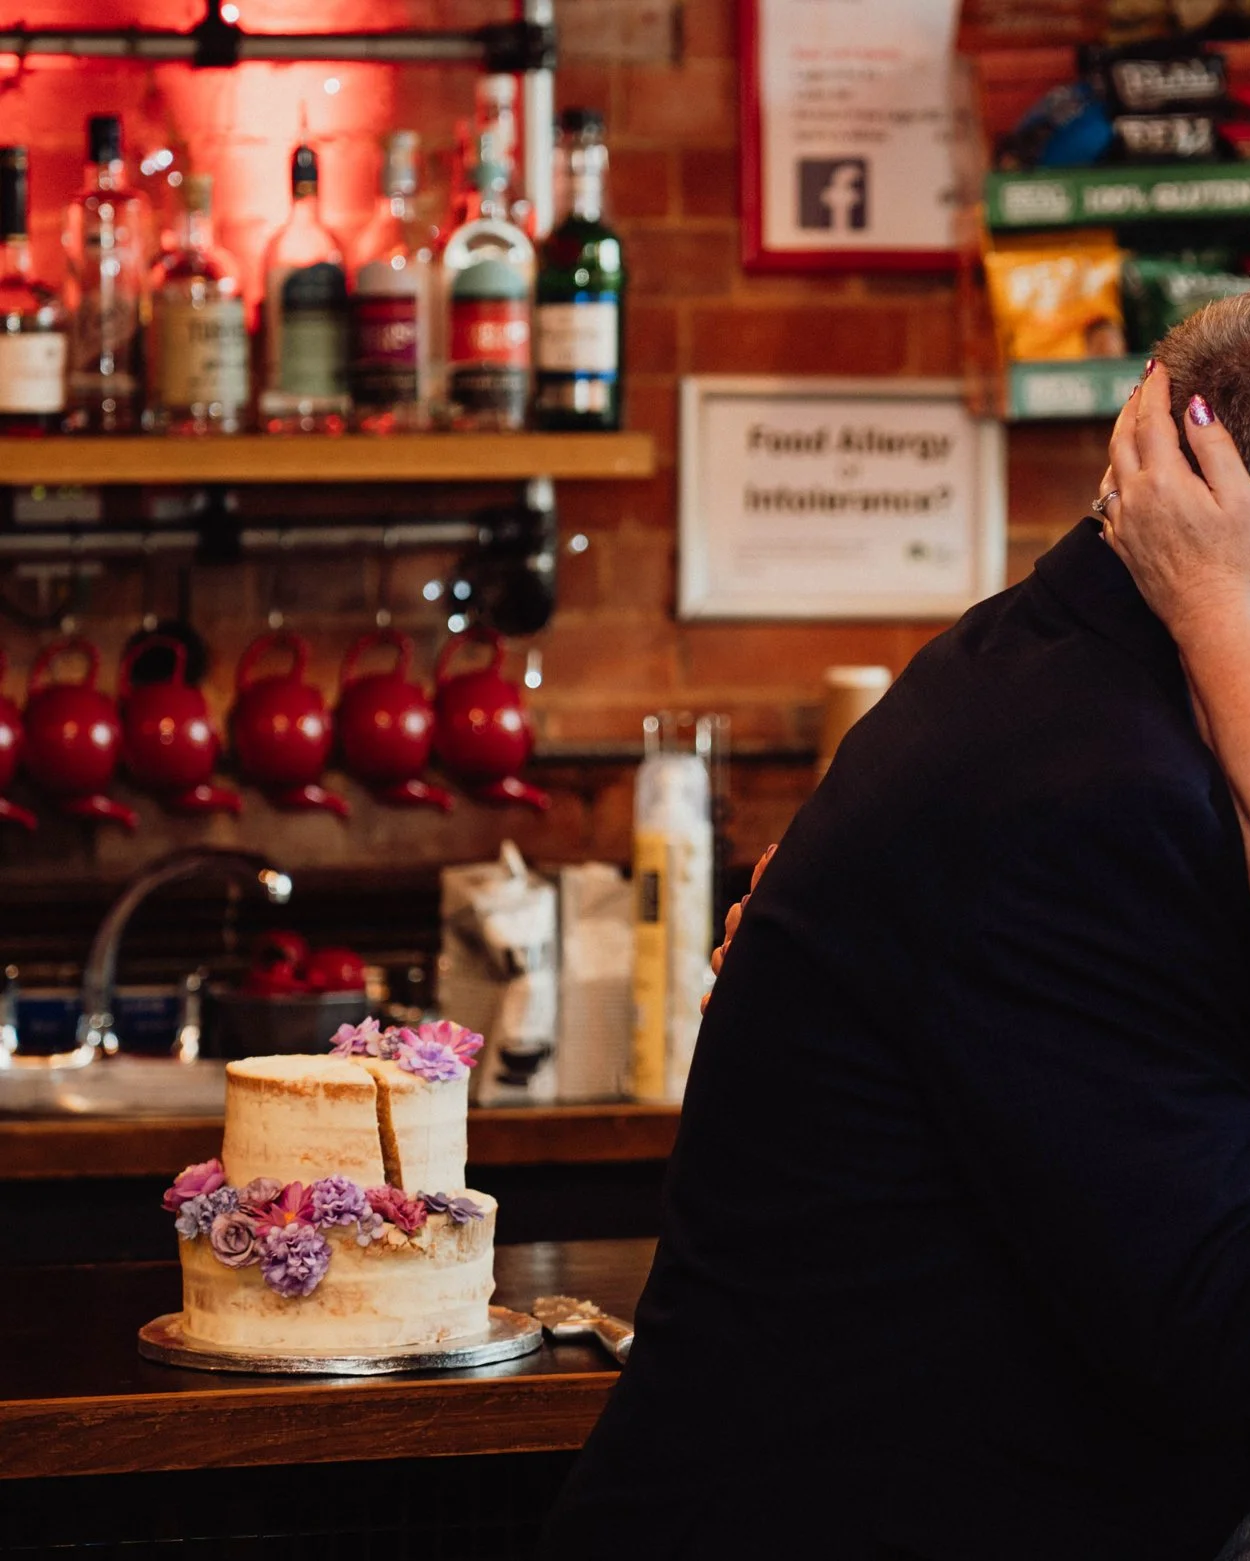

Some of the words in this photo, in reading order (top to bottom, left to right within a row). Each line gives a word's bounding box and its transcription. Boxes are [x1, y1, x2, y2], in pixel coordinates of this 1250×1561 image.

[747, 425, 827, 455] Food
[839, 426, 952, 461] Allergy
[744, 484, 952, 514] Intolerance?
